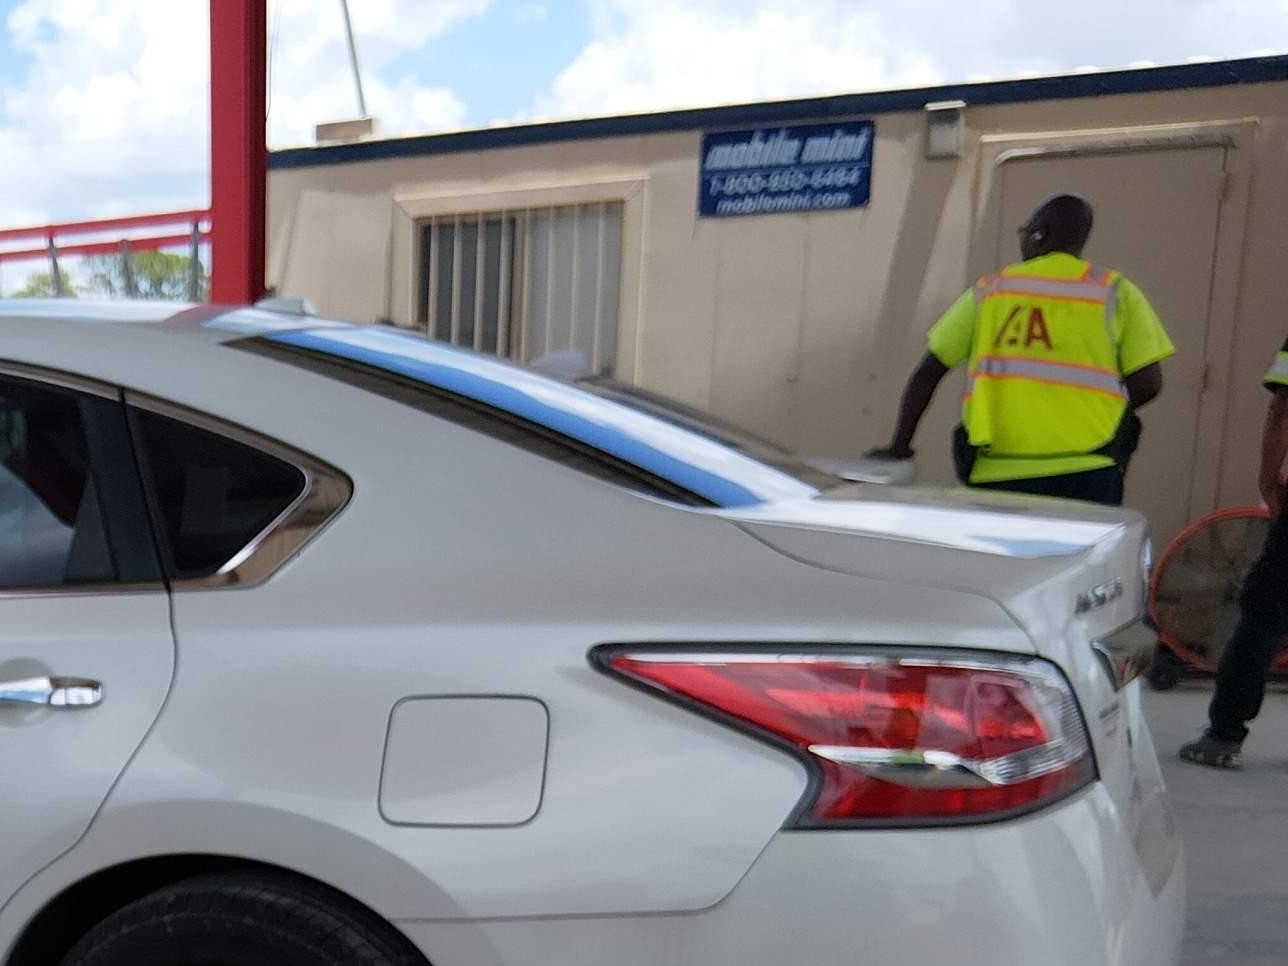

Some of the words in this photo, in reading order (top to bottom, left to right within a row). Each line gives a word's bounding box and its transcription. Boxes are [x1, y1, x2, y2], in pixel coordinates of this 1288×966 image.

[705, 129, 802, 171] mobile
[801, 126, 872, 164] mini
[715, 191, 852, 215] mobilemini.com
